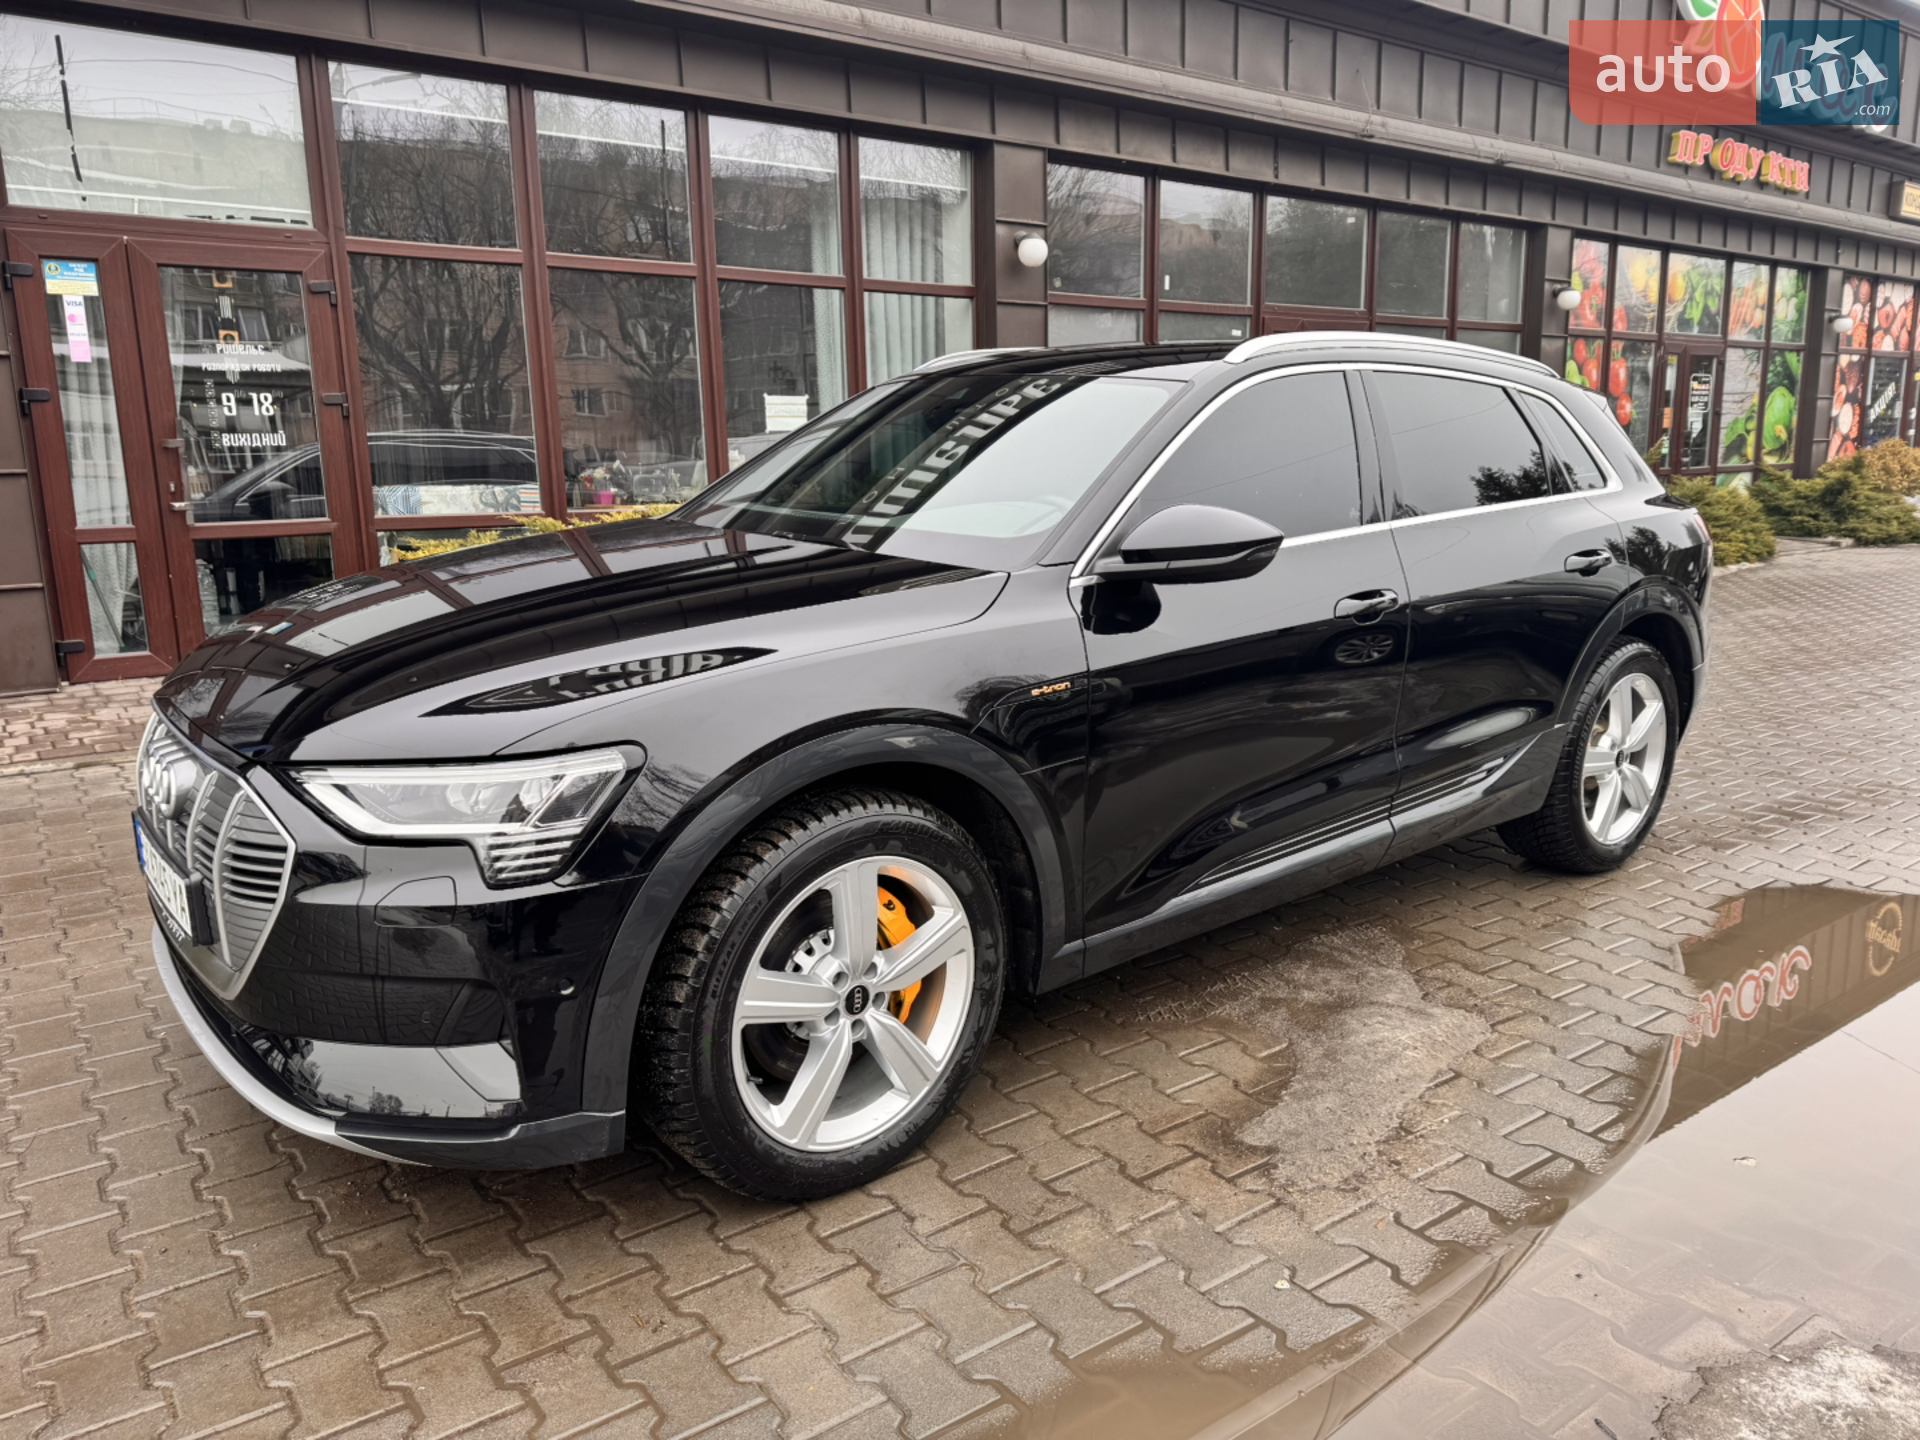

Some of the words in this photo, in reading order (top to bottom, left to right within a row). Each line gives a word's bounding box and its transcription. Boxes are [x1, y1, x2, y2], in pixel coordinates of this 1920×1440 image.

[1669, 129, 1810, 192] ПРОДУКТИ
[65, 300, 84, 308] VISA
[221, 392, 237, 417] 9
[248, 392, 275, 417] 18
[221, 430, 287, 448] ВИХІДНИЙ
[1031, 681, 1071, 697] e-tron
